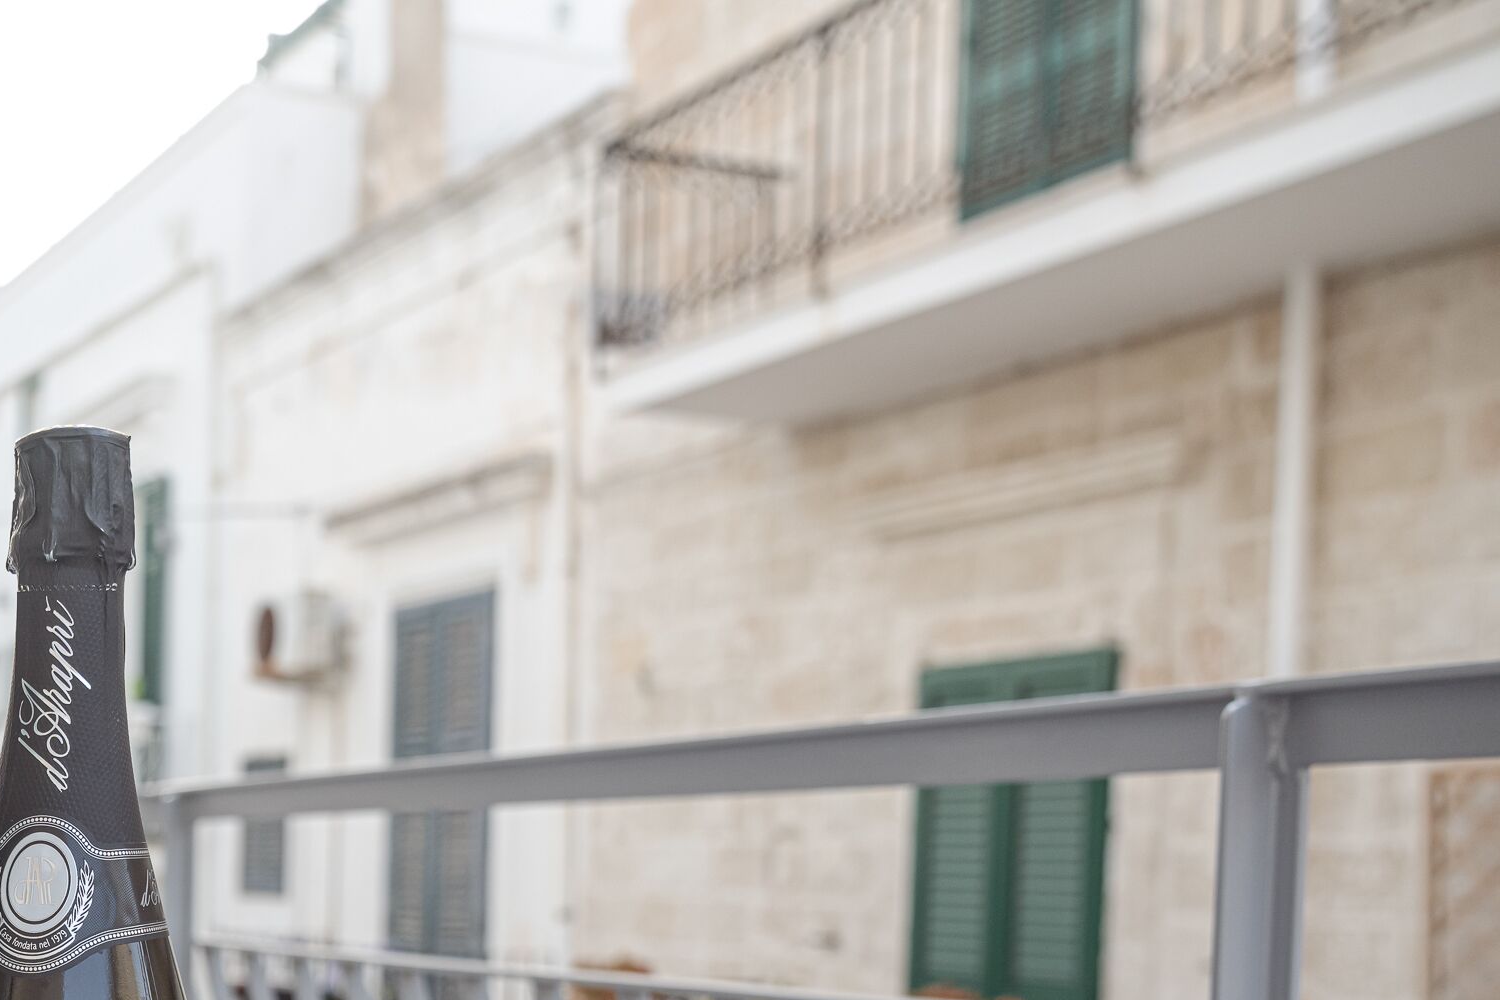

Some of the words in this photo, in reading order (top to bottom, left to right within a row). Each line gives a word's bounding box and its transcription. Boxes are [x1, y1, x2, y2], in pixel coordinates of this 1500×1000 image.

[0, 927, 12, 943] Casa
[11, 936, 38, 951] fondata
[38, 938, 51, 949] nel
[50, 929, 68, 944] 1979
